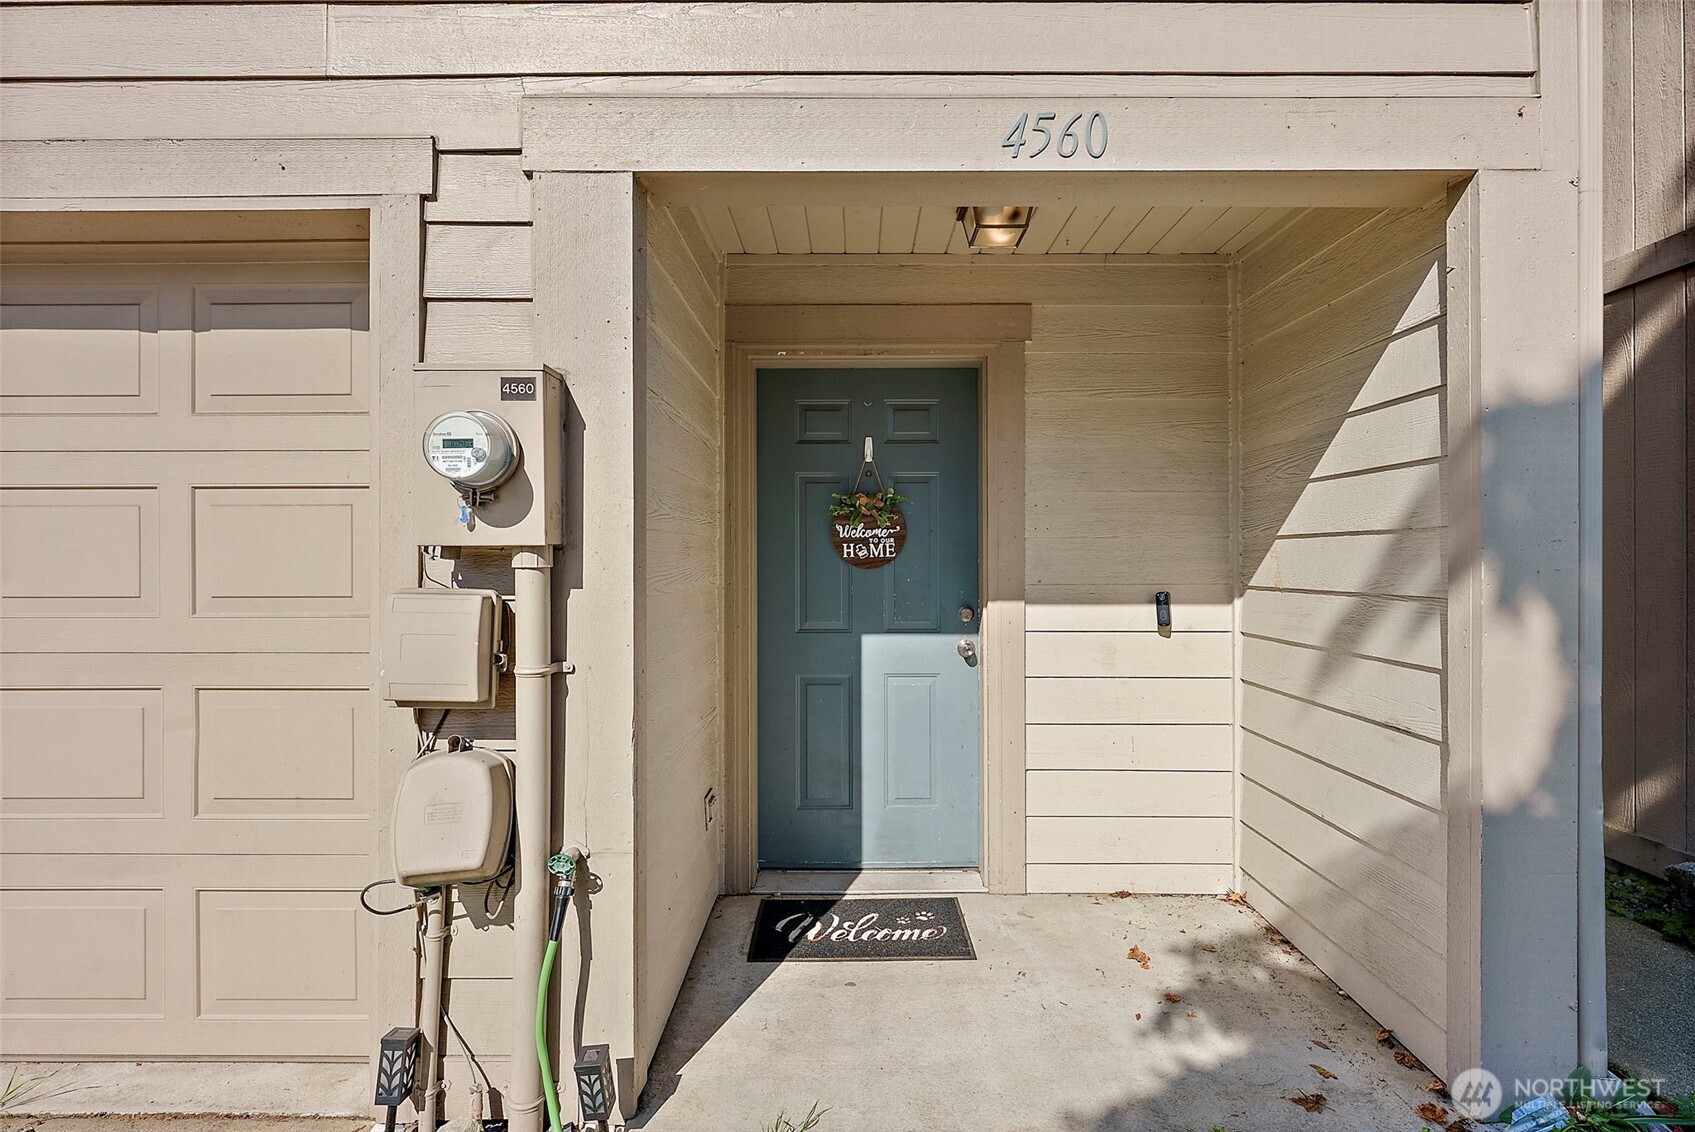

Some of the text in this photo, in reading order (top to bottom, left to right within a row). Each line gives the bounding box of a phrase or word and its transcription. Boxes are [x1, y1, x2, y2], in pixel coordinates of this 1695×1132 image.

[1002, 111, 1108, 158] 4560
[502, 383, 534, 394] 4560
[835, 523, 900, 538] Welcome
[775, 912, 947, 942] Welcome
